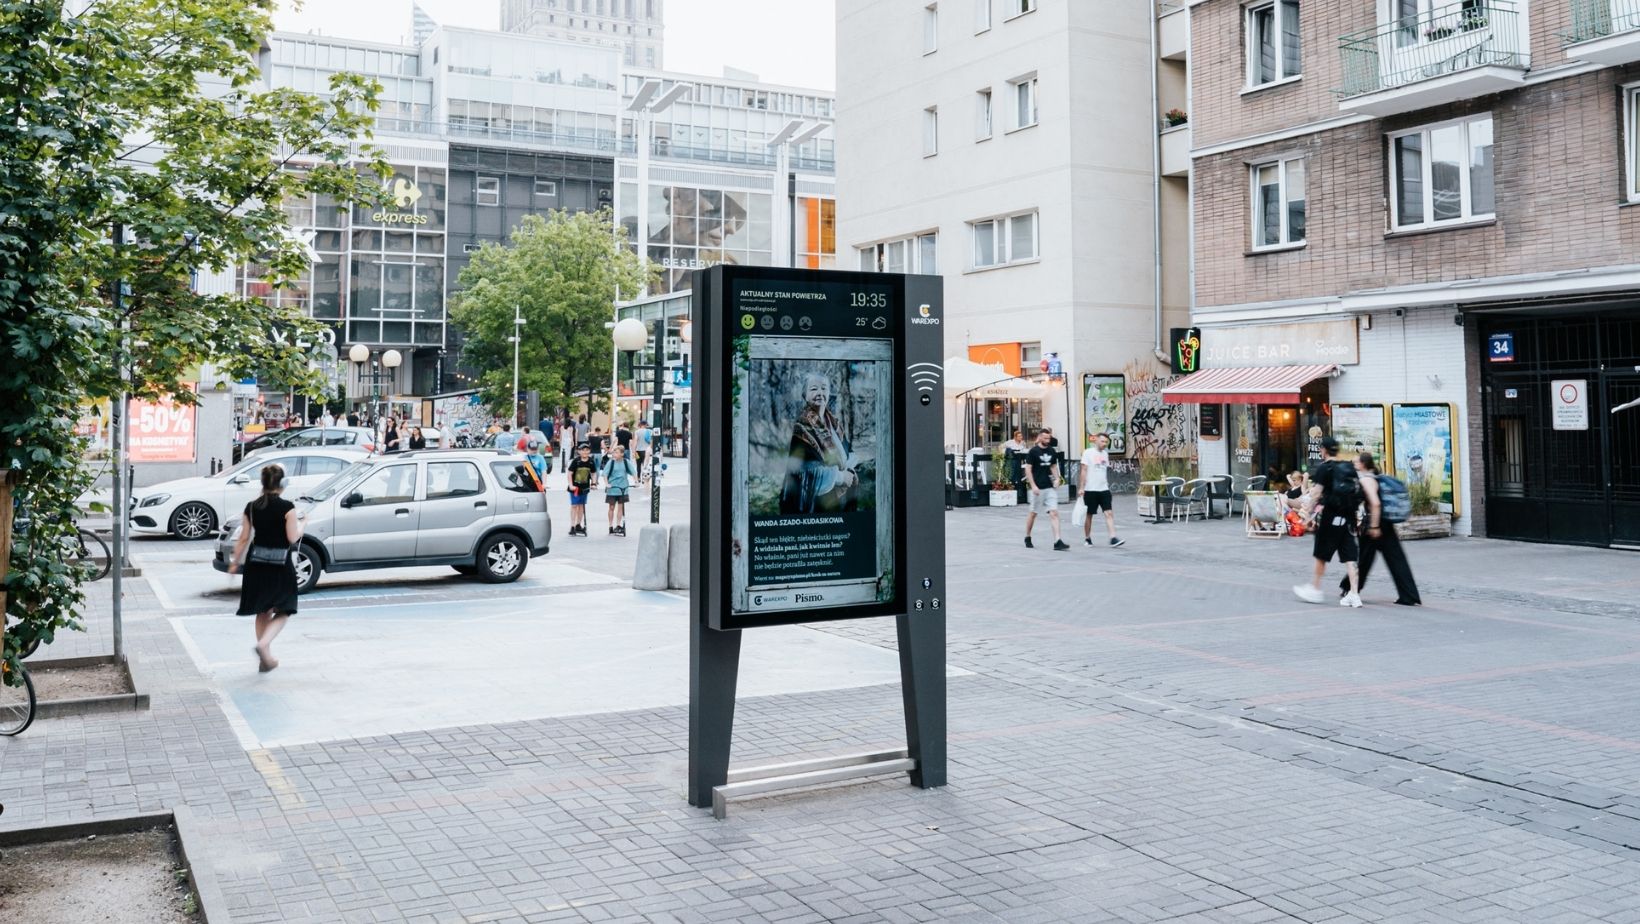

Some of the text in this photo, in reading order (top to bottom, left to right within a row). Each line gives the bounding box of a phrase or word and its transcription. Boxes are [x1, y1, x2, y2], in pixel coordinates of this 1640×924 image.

[372, 212, 428, 225] express
[740, 290, 827, 300] AKTUALNY STAN POWIETRZA
[850, 292, 887, 308] 19:35
[911, 317, 940, 325] WAREXPO
[1206, 343, 1290, 361] JUICE BAR
[1493, 340, 1509, 354] 34
[1413, 410, 1447, 419] MIASTOWE
[754, 562, 763, 570] nie
[795, 593, 825, 604] Pismo.
